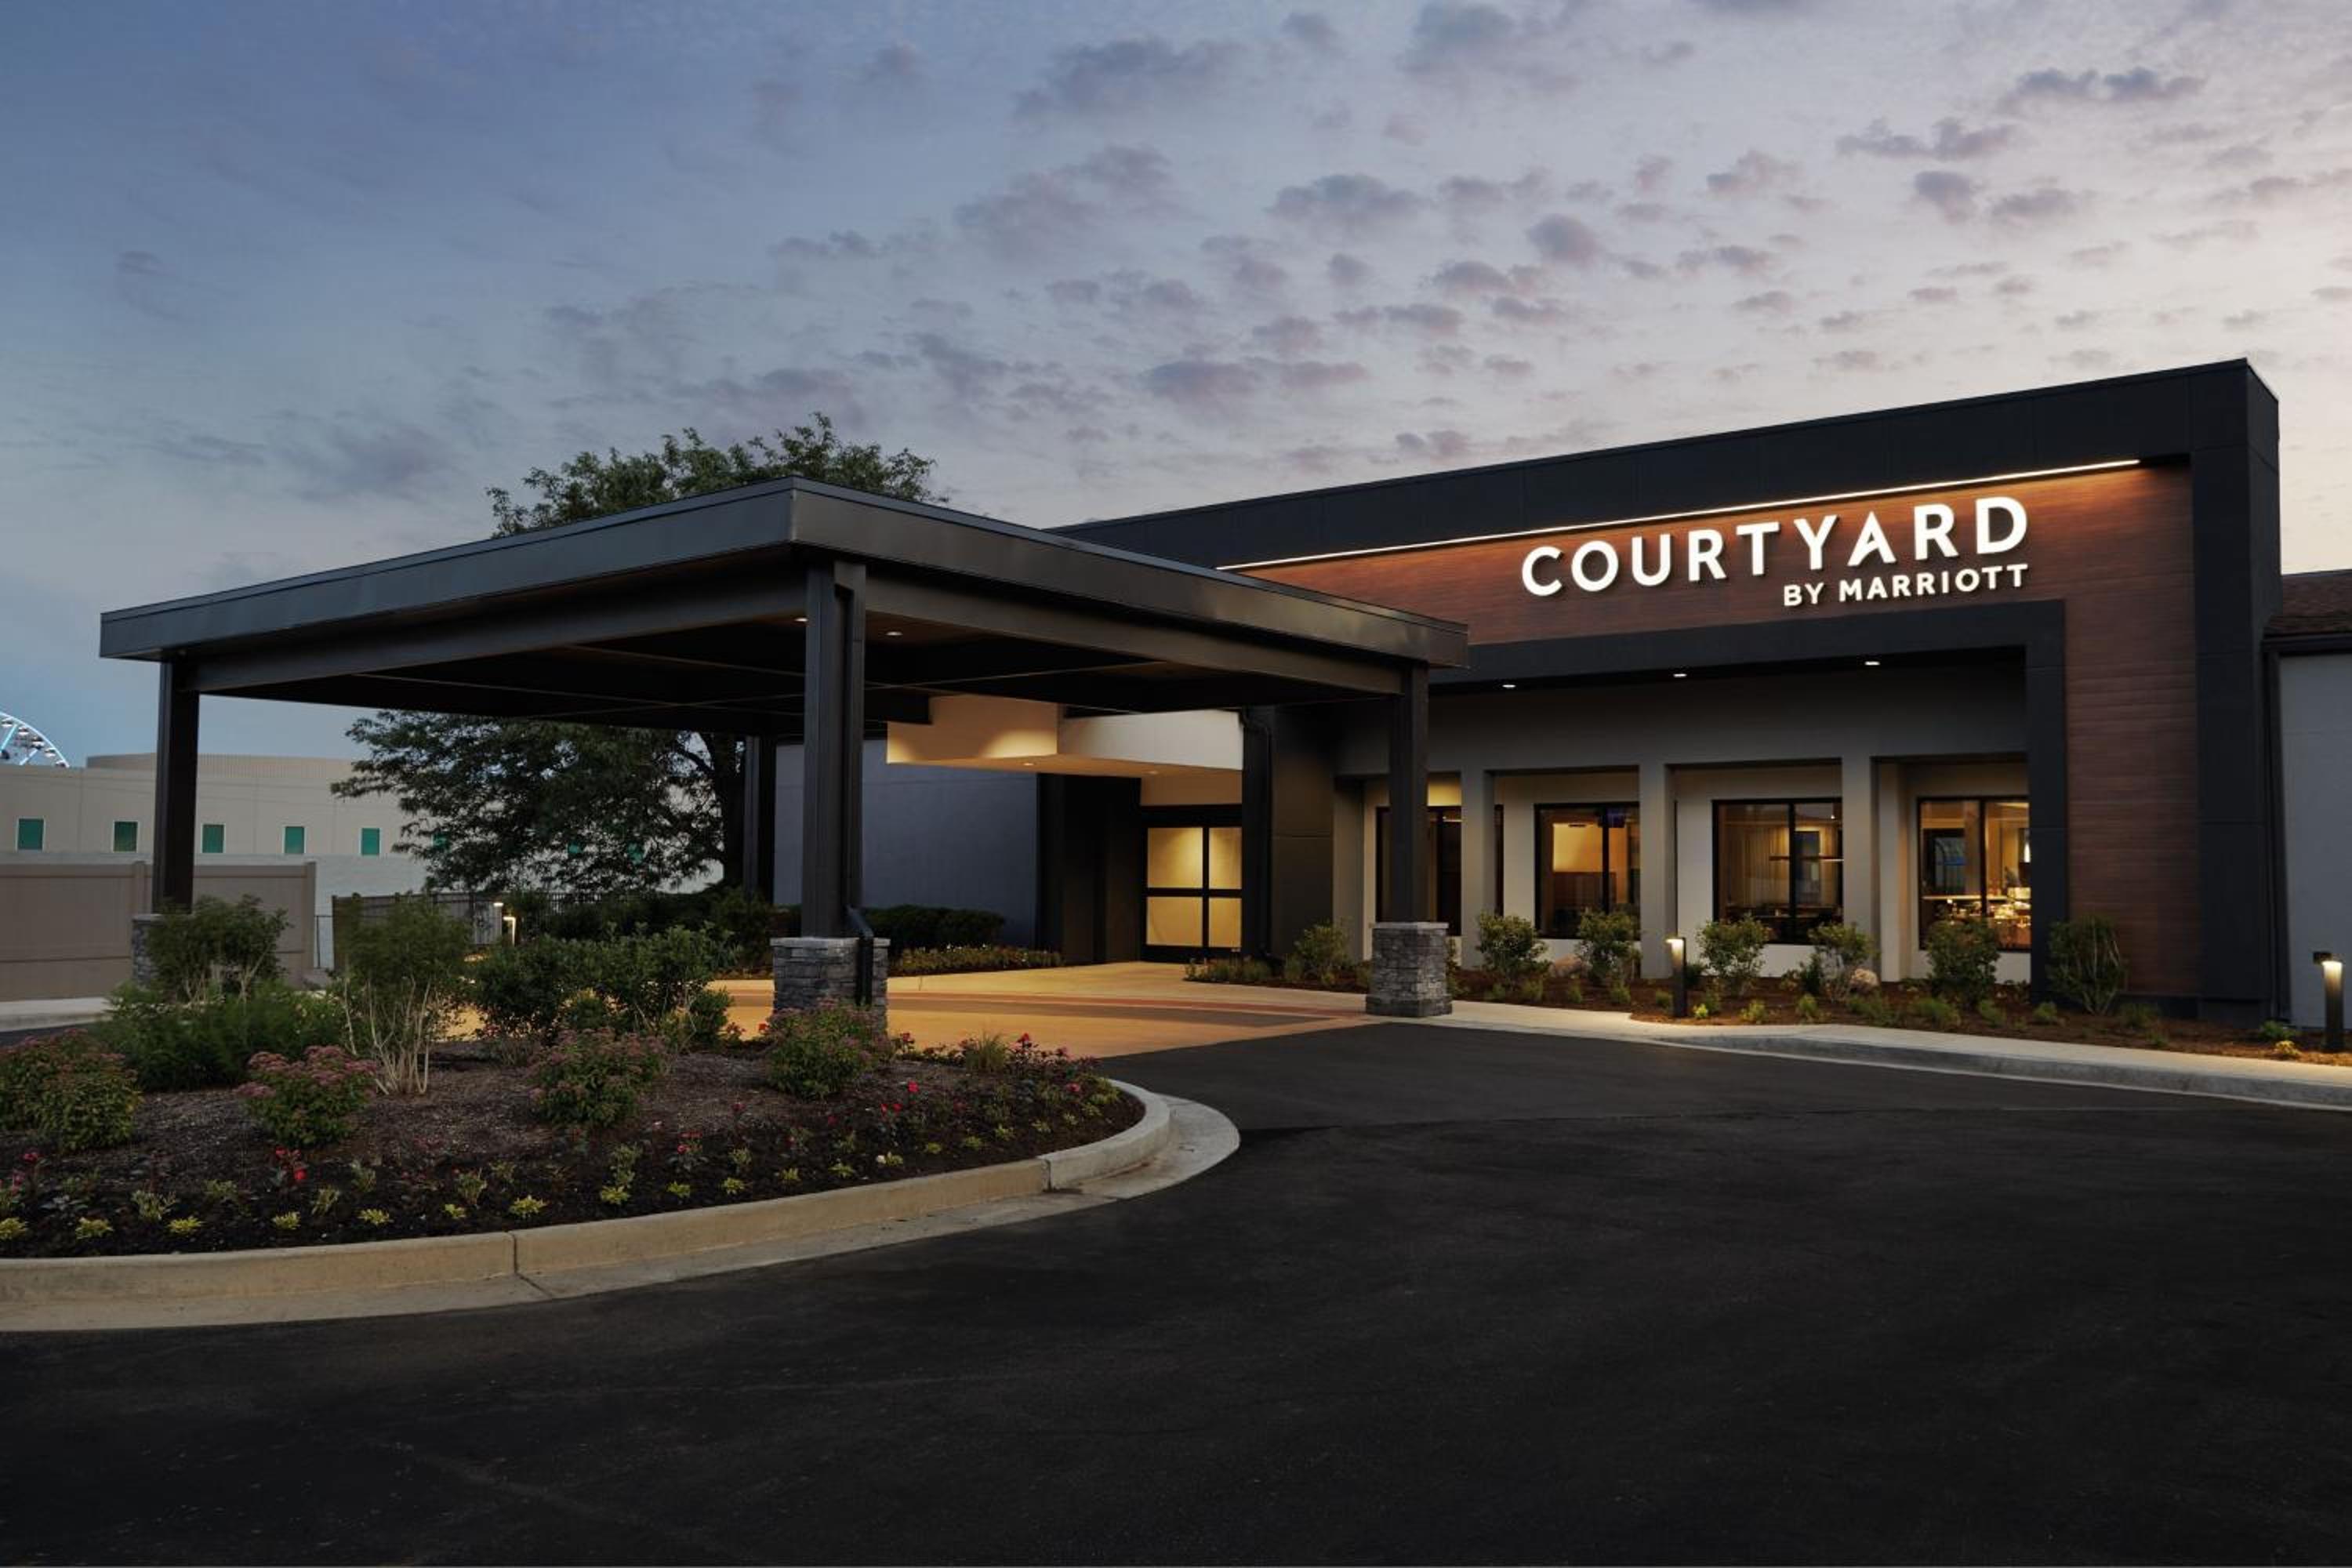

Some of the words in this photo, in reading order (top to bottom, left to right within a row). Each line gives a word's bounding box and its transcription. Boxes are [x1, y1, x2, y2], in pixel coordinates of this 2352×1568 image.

[1521, 495, 2028, 597] COURTYARD
[1783, 583, 1824, 607] BY
[1838, 563, 2029, 602] MARRIOTT
